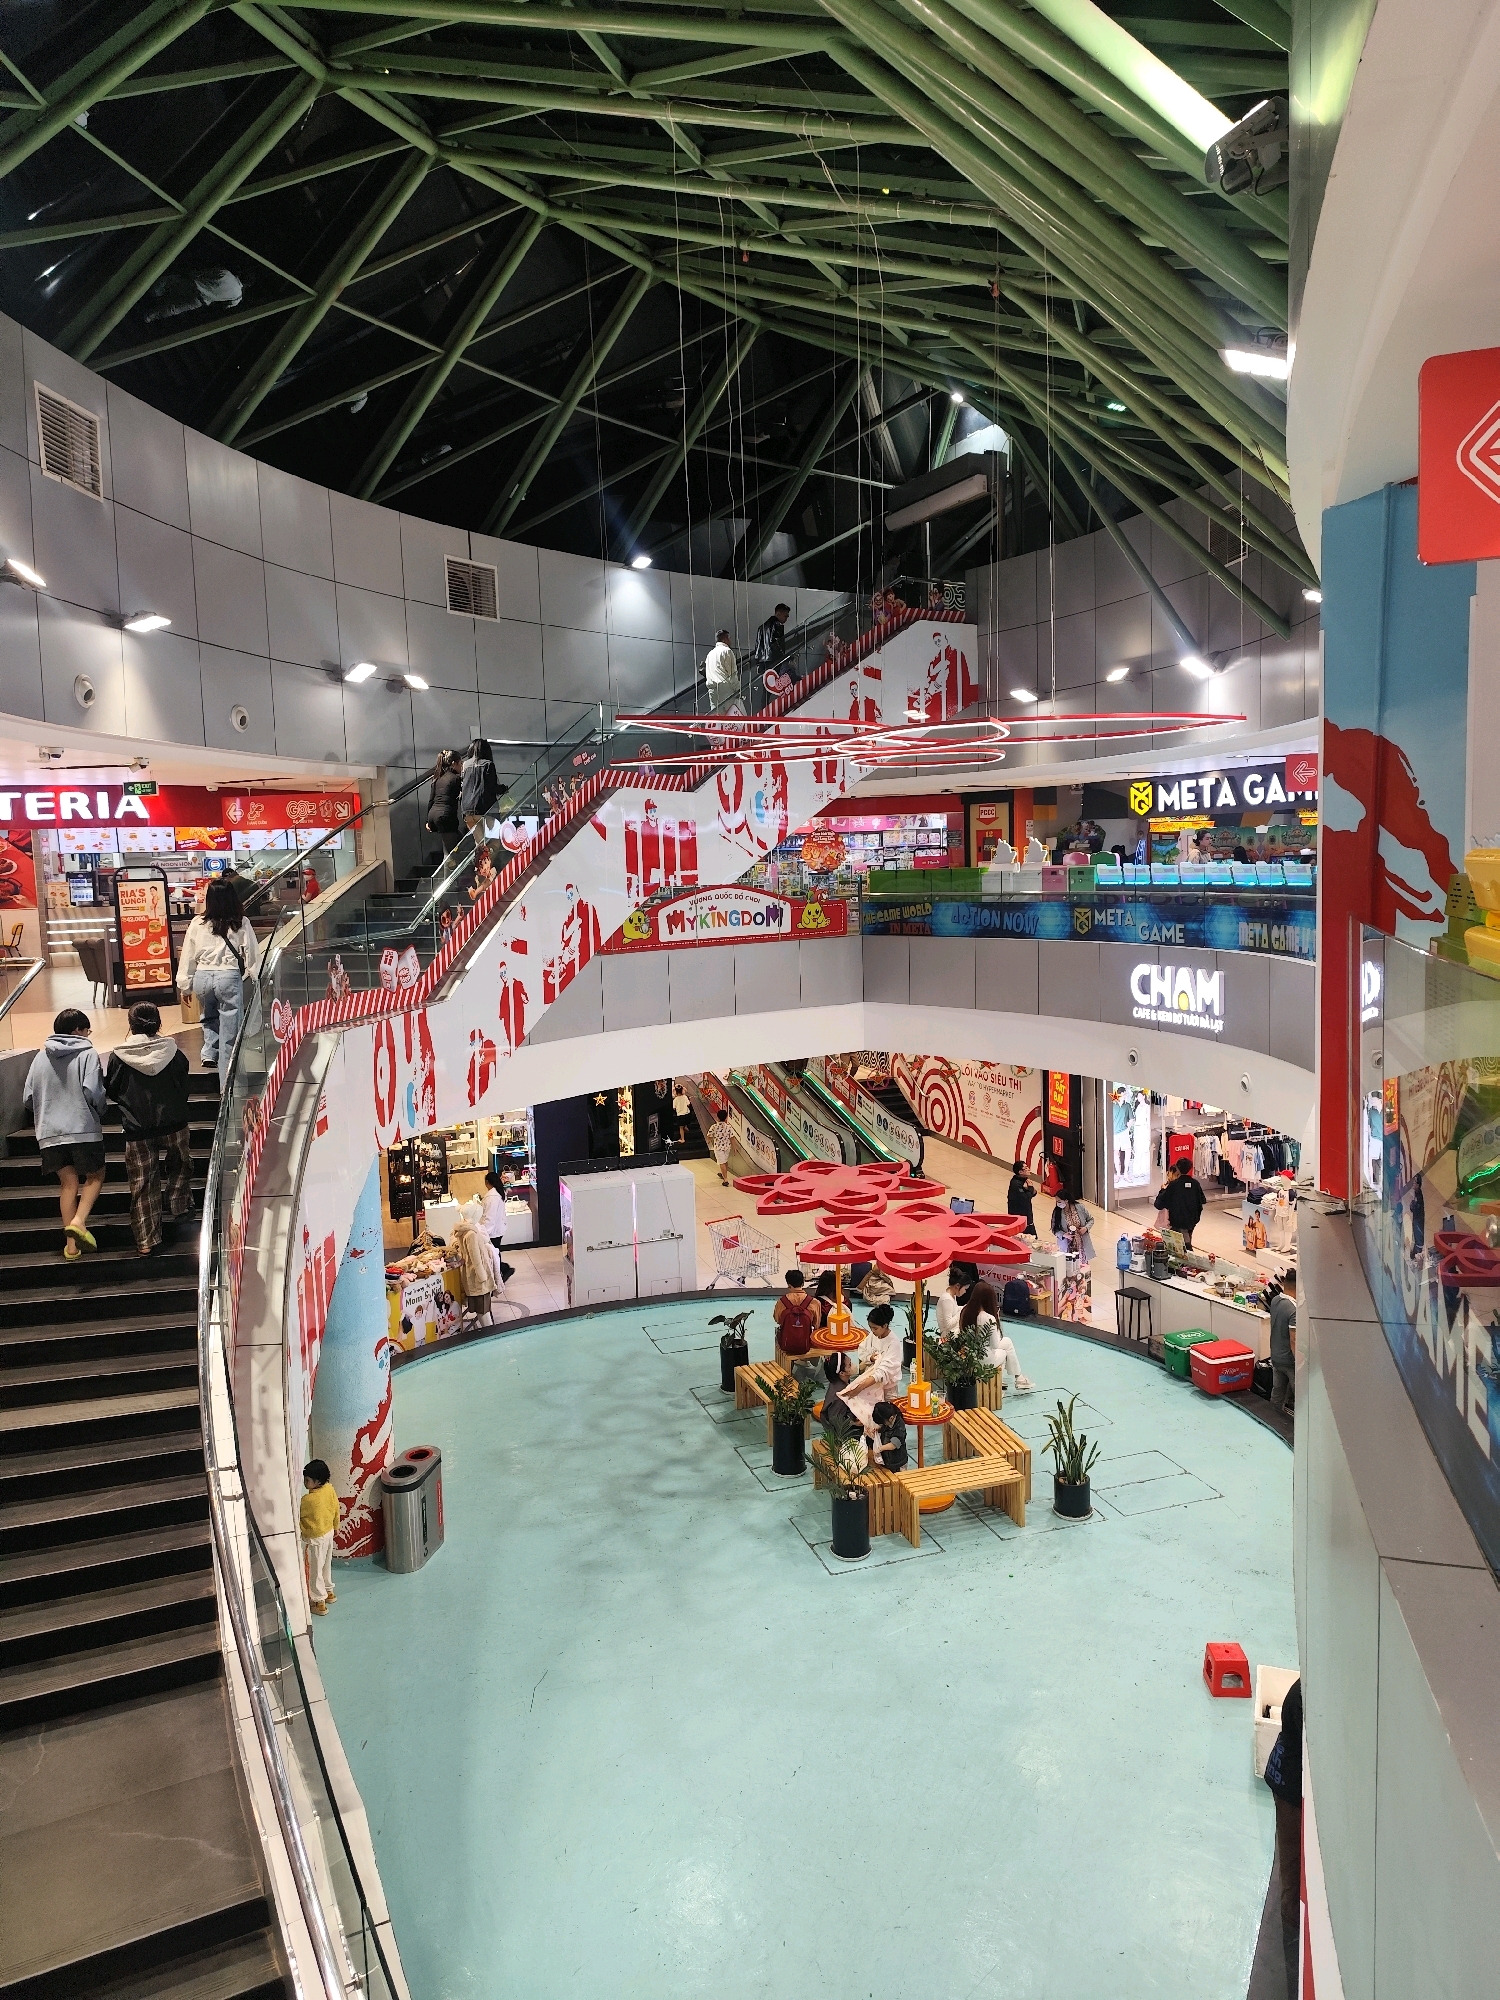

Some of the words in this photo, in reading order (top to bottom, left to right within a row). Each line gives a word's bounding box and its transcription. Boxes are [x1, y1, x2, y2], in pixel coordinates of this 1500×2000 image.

[1158, 777, 1237, 813] META
[1243, 772, 1318, 806] GA
[120, 888, 146, 899] RIA'S
[121, 898, 147, 906] LUNCH
[877, 908, 901, 923] GAME
[902, 902, 932, 919] WORLD
[951, 905, 1000, 929] ACTION
[1003, 912, 1040, 935] NOW
[1094, 908, 1135, 927] META
[889, 922, 900, 935] IN
[902, 922, 932, 935] META
[1138, 922, 1185, 944] GAME
[1238, 921, 1269, 949] META
[1130, 963, 1225, 1017] CHAM
[1132, 1006, 1151, 1020] CAFE
[990, 1072, 1007, 1087] SIÊU
[983, 1084, 1015, 1100] HYPERMARKET
[405, 1296, 423, 1308] Mom
